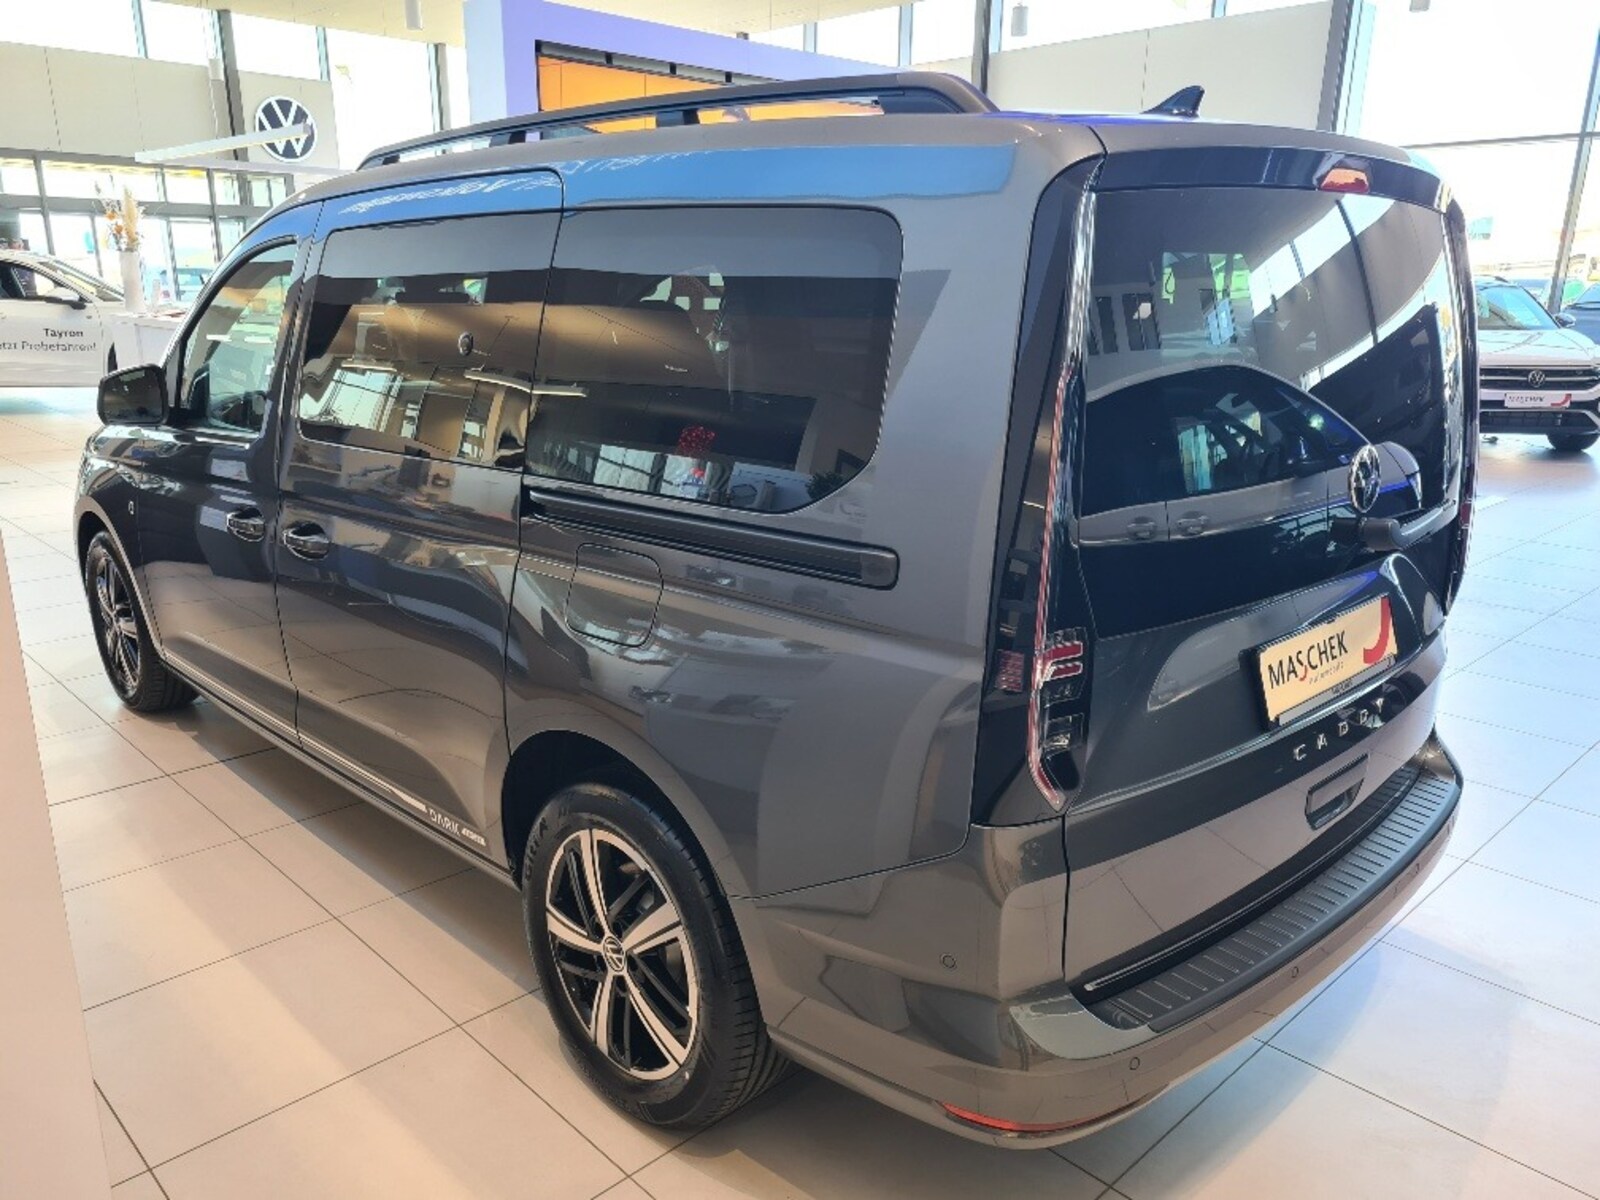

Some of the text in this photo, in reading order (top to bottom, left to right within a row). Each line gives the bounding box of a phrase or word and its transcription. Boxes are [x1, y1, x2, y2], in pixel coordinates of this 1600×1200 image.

[43, 327, 84, 339] Tayron
[1268, 630, 1349, 690] MASCHEK
[1293, 697, 1385, 761] CADDY
